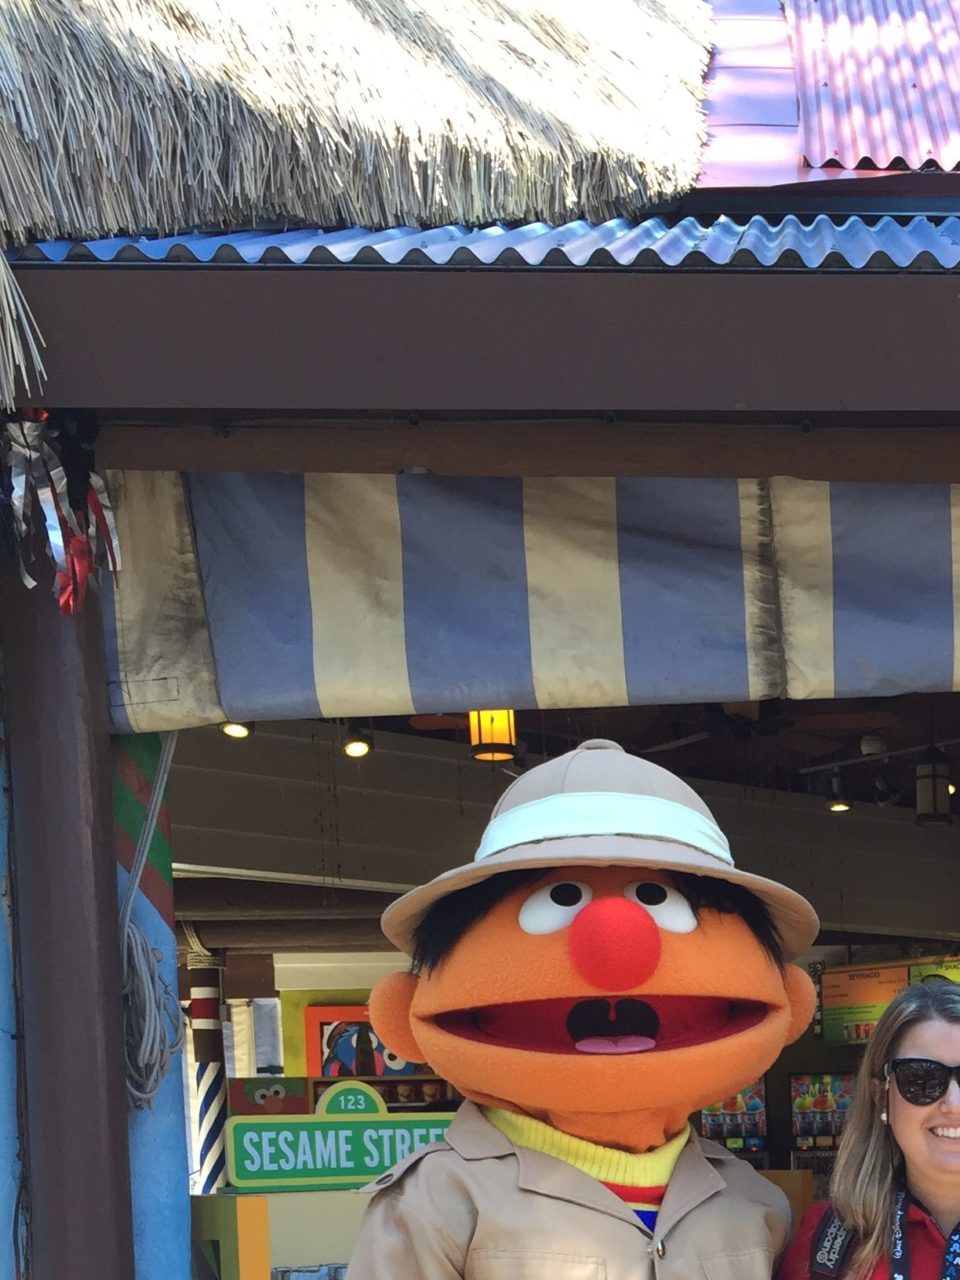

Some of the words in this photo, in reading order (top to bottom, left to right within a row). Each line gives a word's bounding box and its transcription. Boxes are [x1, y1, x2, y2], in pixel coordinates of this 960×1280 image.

[849, 971, 880, 981] BEVERAGES
[339, 1095, 365, 1109] 123
[243, 1129, 354, 1172] SESAME
[826, 1222, 849, 1269] uperdry
